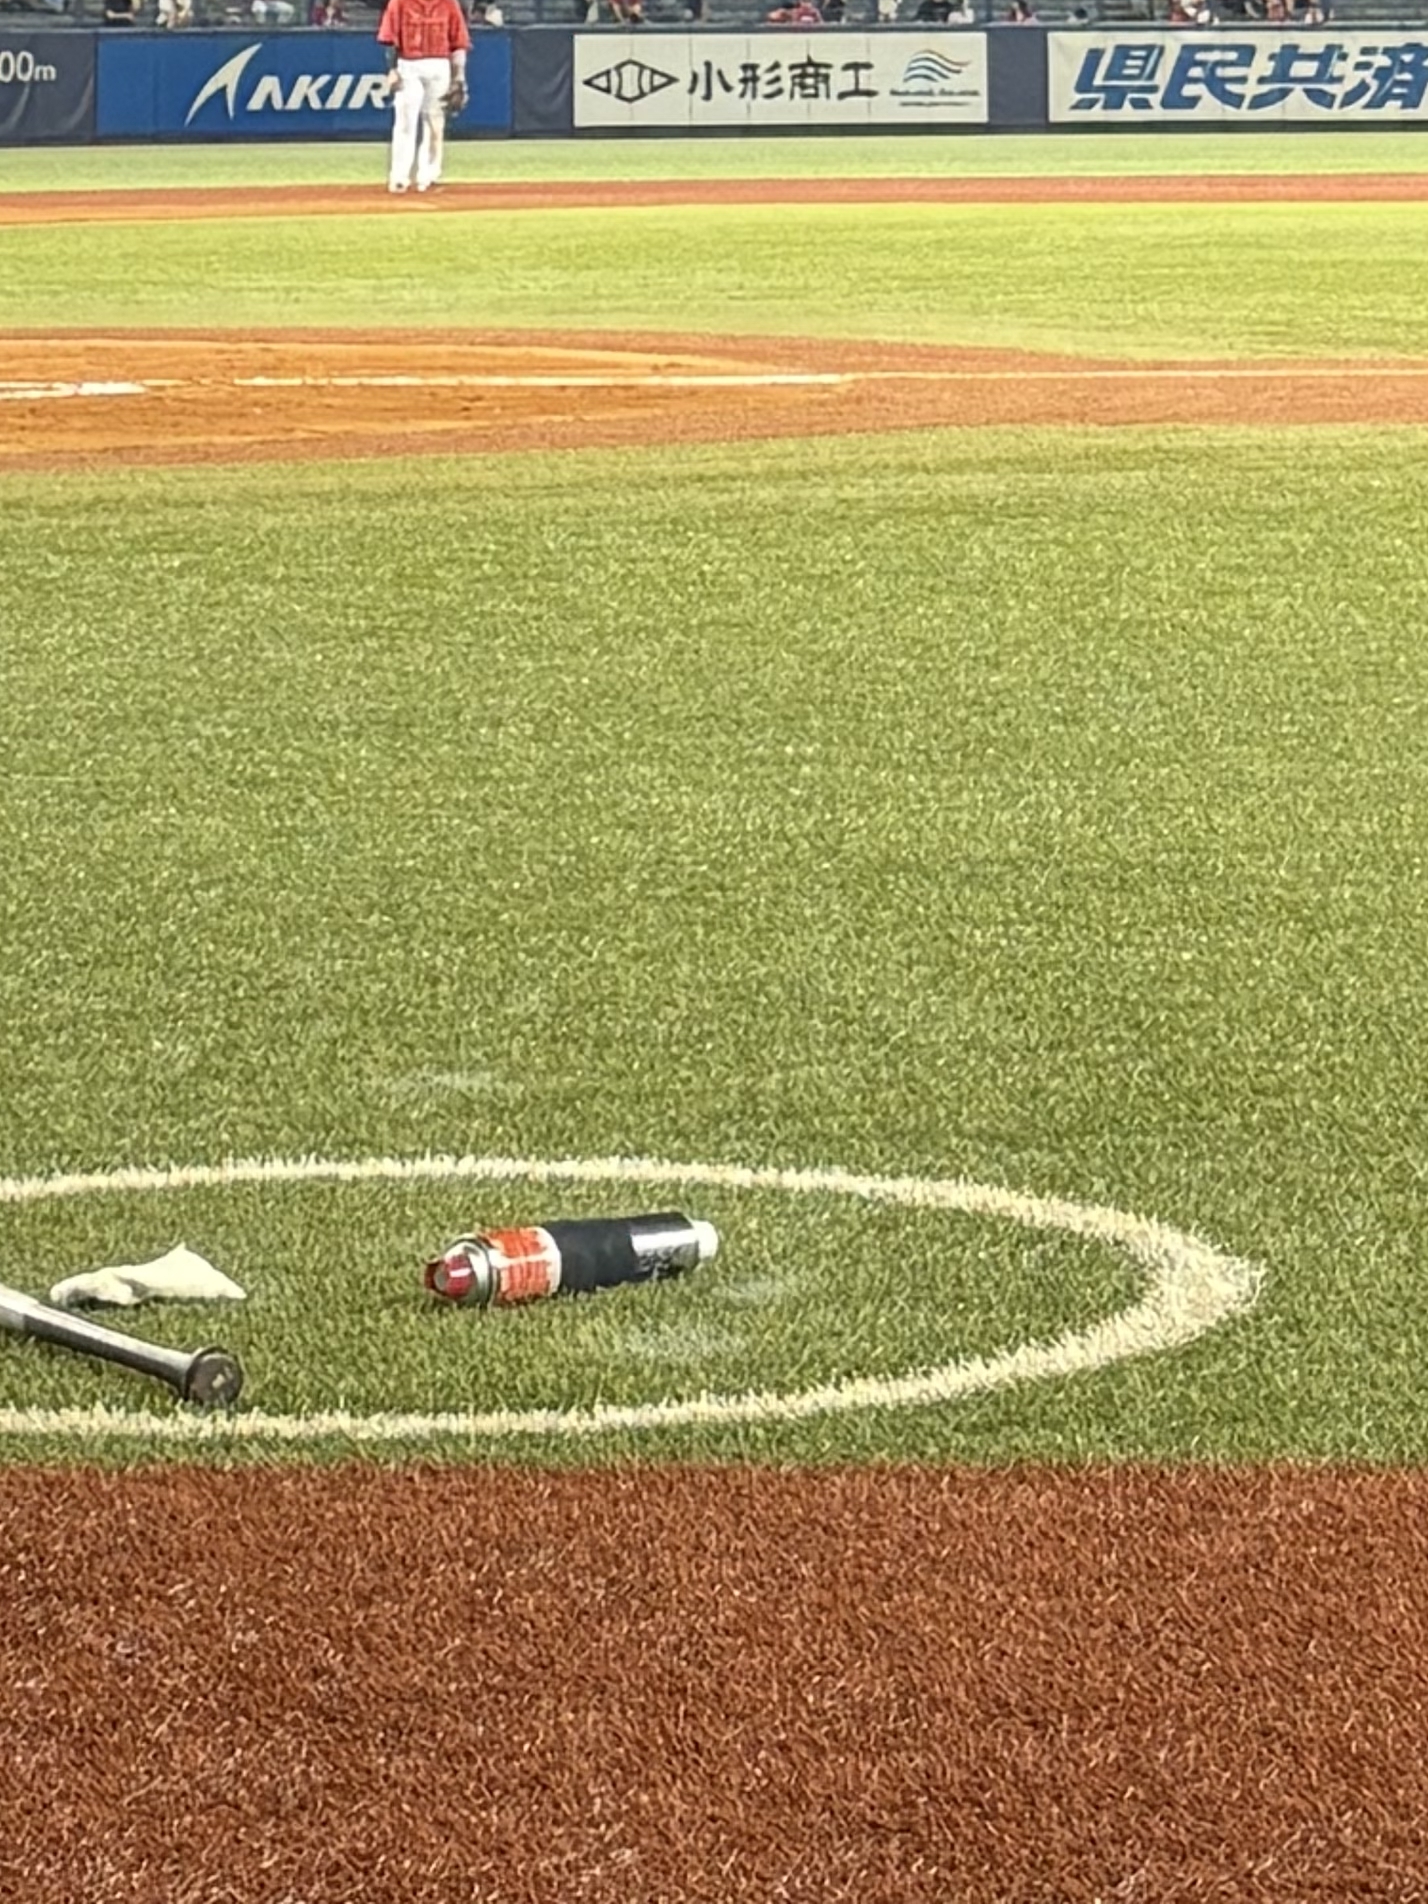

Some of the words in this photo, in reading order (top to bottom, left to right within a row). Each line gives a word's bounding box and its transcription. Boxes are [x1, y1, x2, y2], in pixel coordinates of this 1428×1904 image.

[246, 74, 396, 110] AKIR
[688, 54, 879, 102] 小形商工
